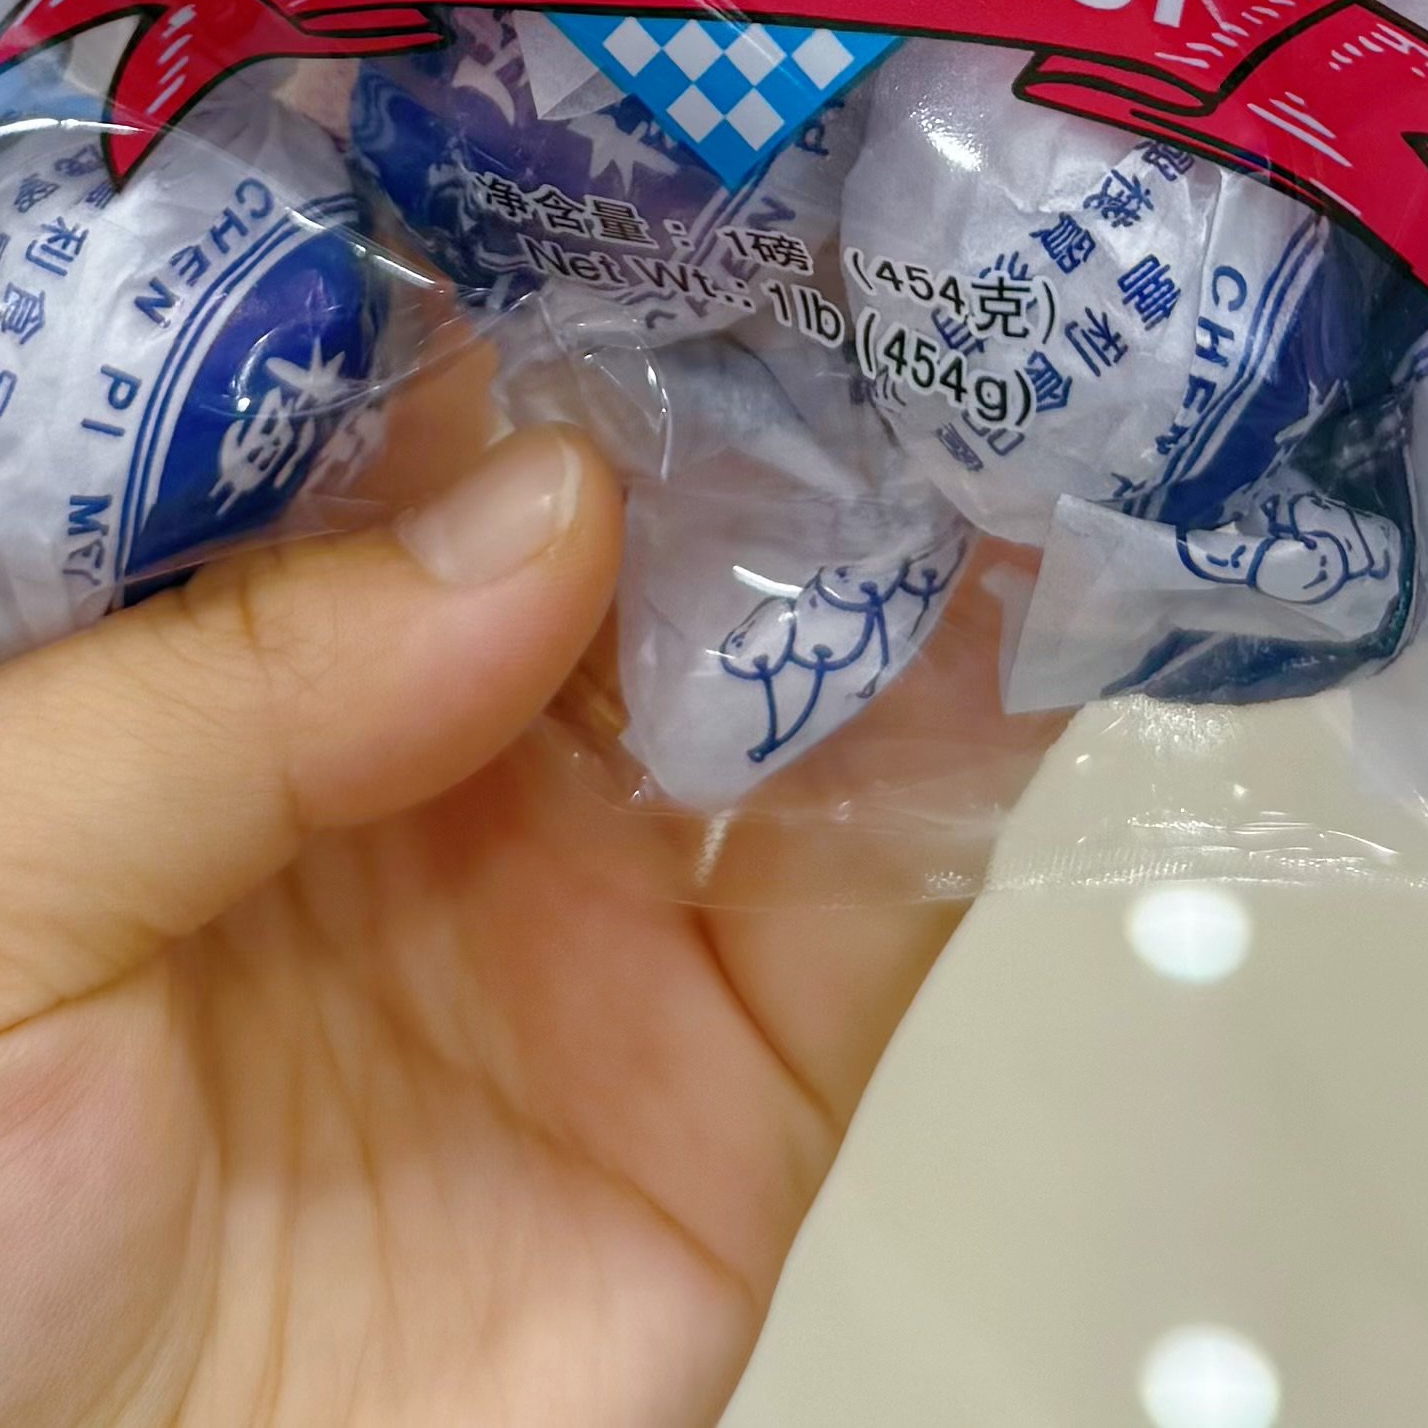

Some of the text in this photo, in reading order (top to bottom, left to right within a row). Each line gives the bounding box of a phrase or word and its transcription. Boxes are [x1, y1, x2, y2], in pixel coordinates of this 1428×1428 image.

[134, 178, 275, 329] CHEN
[848, 250, 1058, 342] (454克)
[523, 240, 620, 284] Net
[857, 312, 1033, 424] (454g)
[81, 366, 142, 438] PI
